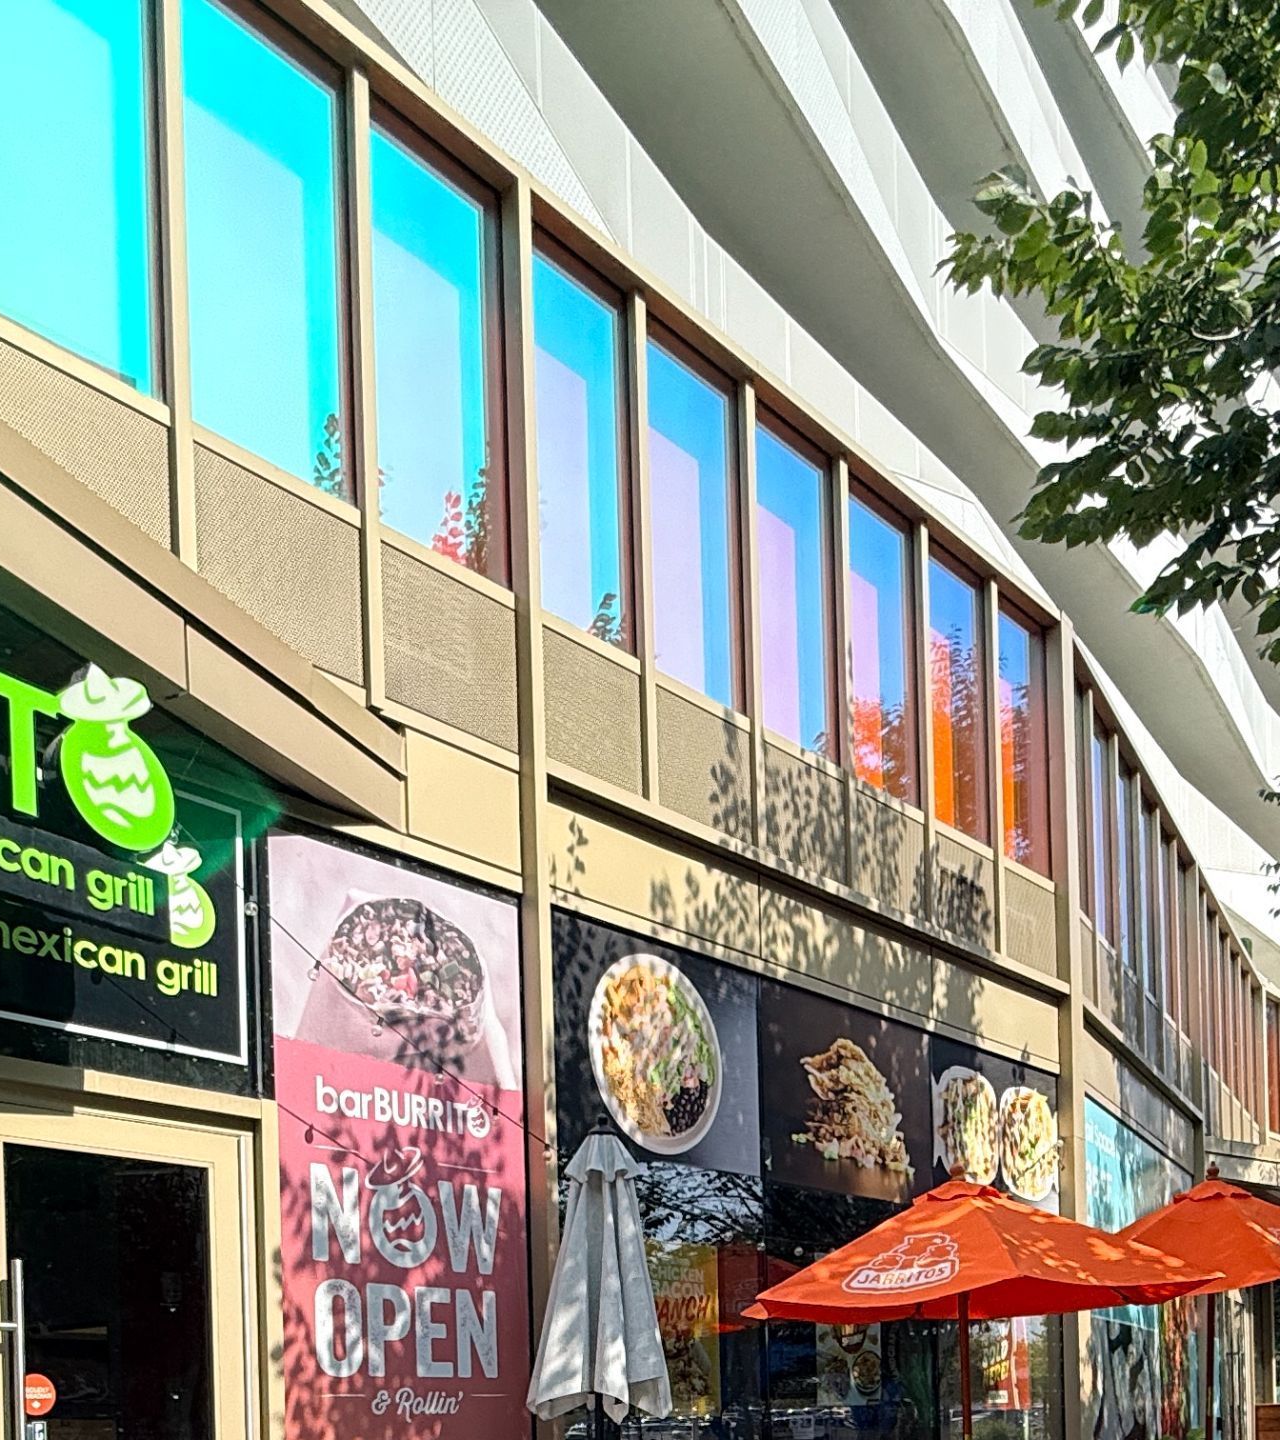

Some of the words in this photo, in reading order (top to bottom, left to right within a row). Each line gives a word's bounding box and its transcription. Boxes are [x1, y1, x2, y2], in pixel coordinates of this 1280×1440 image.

[86, 868, 155, 917] grill
[155, 955, 218, 998] grill
[310, 1147, 502, 1275] NOW
[650, 1264, 705, 1283] CHICKEN
[857, 1265, 948, 1285] JARRITOS
[656, 1294, 711, 1324] ANCH
[315, 1278, 499, 1379] OPEN
[372, 1390, 391, 1415] &
[396, 1387, 464, 1421] Rollin'
